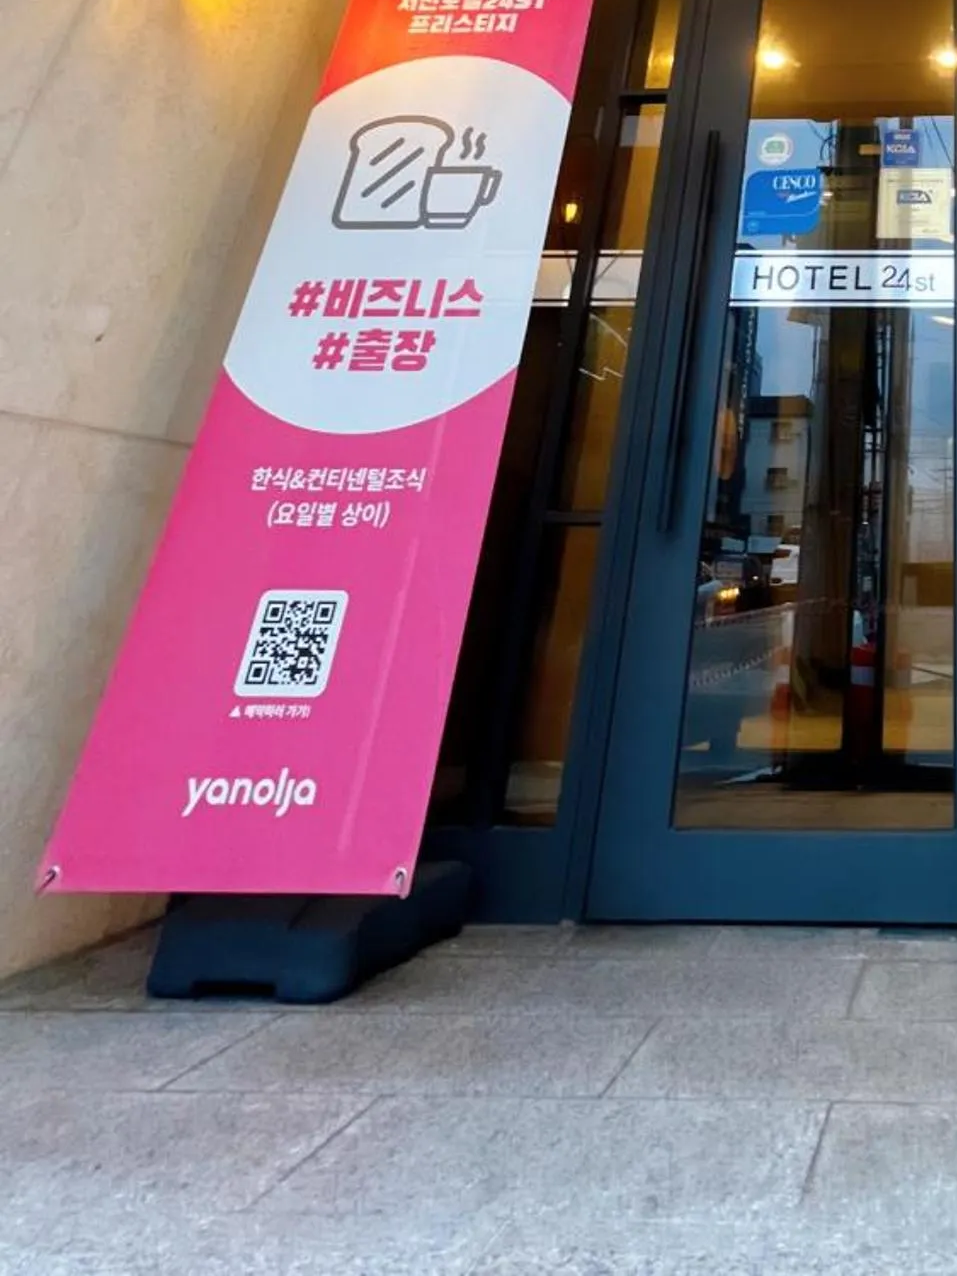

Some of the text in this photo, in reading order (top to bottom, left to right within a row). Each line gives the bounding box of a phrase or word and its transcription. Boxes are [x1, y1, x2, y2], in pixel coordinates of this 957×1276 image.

[773, 176, 816, 190] CESCO
[753, 265, 935, 291] HOTEL 24st
[287, 278, 484, 318] #비즈니스
[312, 328, 436, 372] #출장
[267, 501, 391, 528] (요일별 상이)
[181, 767, 317, 817] yanolja
